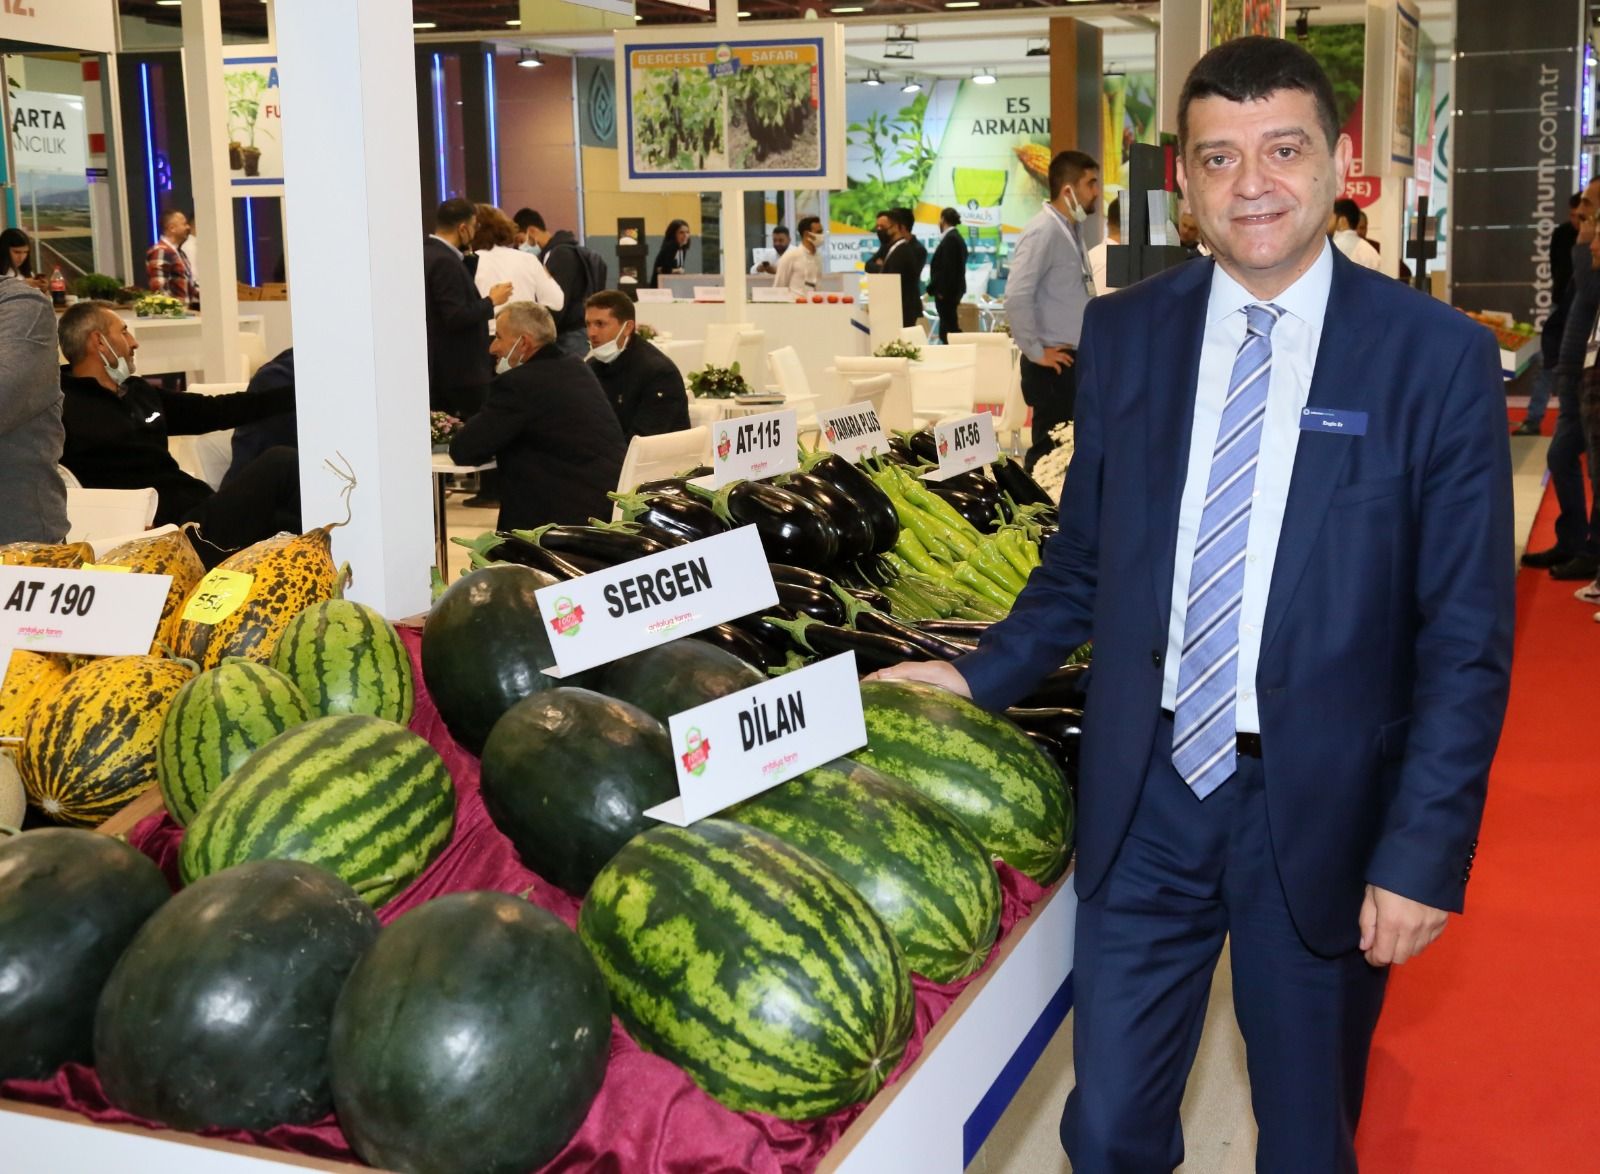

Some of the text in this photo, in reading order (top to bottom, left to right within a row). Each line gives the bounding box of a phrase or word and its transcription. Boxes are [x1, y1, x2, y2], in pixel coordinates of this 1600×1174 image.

[638, 53, 707, 65] BERCESTE
[1006, 97, 1031, 114] ES
[736, 419, 781, 455] AT-115
[829, 410, 881, 442] TAMARA PLUS
[954, 422, 981, 451] AT-56
[4, 580, 95, 616] AT 190
[603, 556, 713, 618] SERGEN
[738, 690, 806, 752] DİLAN
